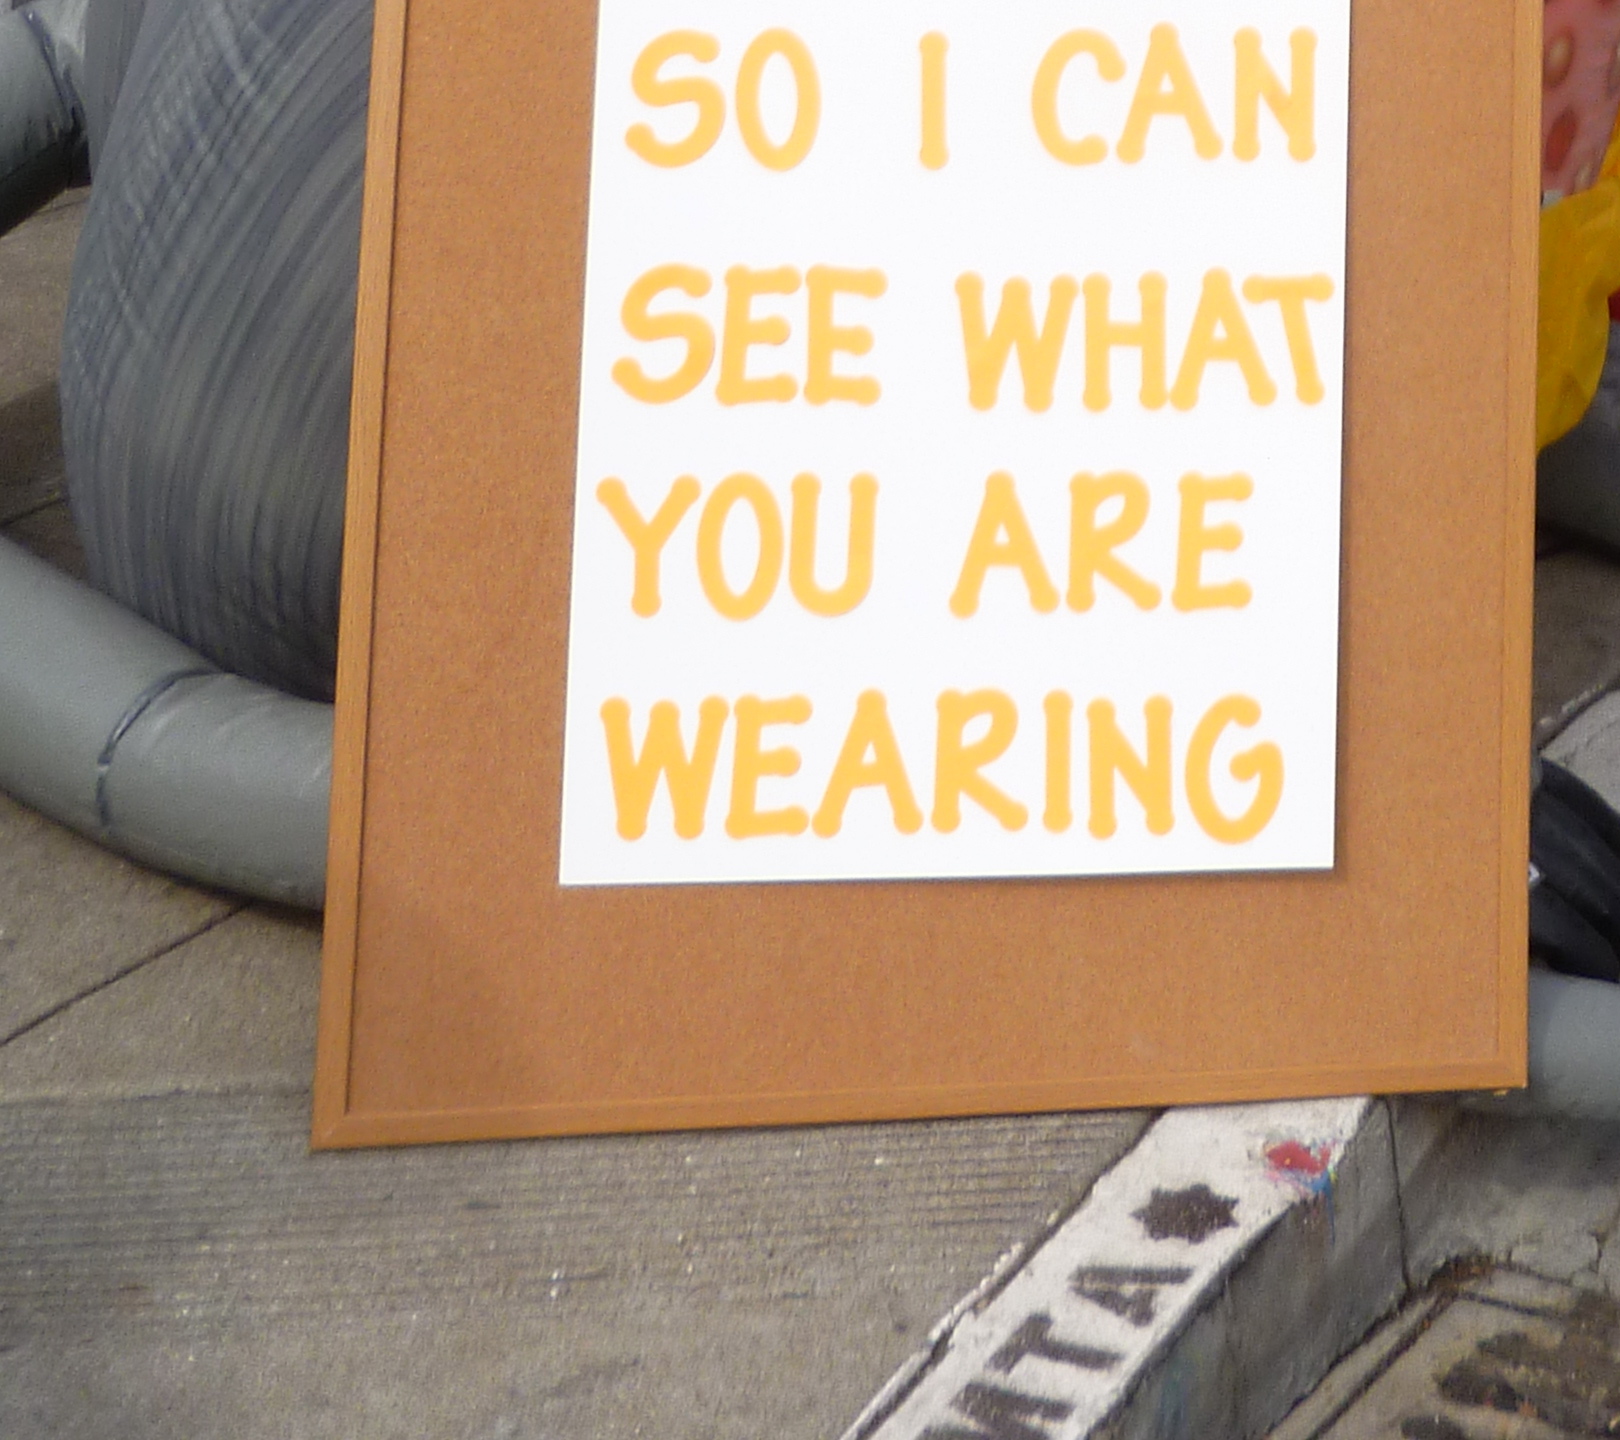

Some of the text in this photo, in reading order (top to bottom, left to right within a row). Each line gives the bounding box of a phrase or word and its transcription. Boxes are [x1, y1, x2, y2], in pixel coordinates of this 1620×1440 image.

[625, 24, 1316, 170] SO I CAN
[612, 264, 1334, 412] SEE WHAT
[596, 472, 1253, 621] YOU ARE
[599, 689, 1284, 845] WEARING
